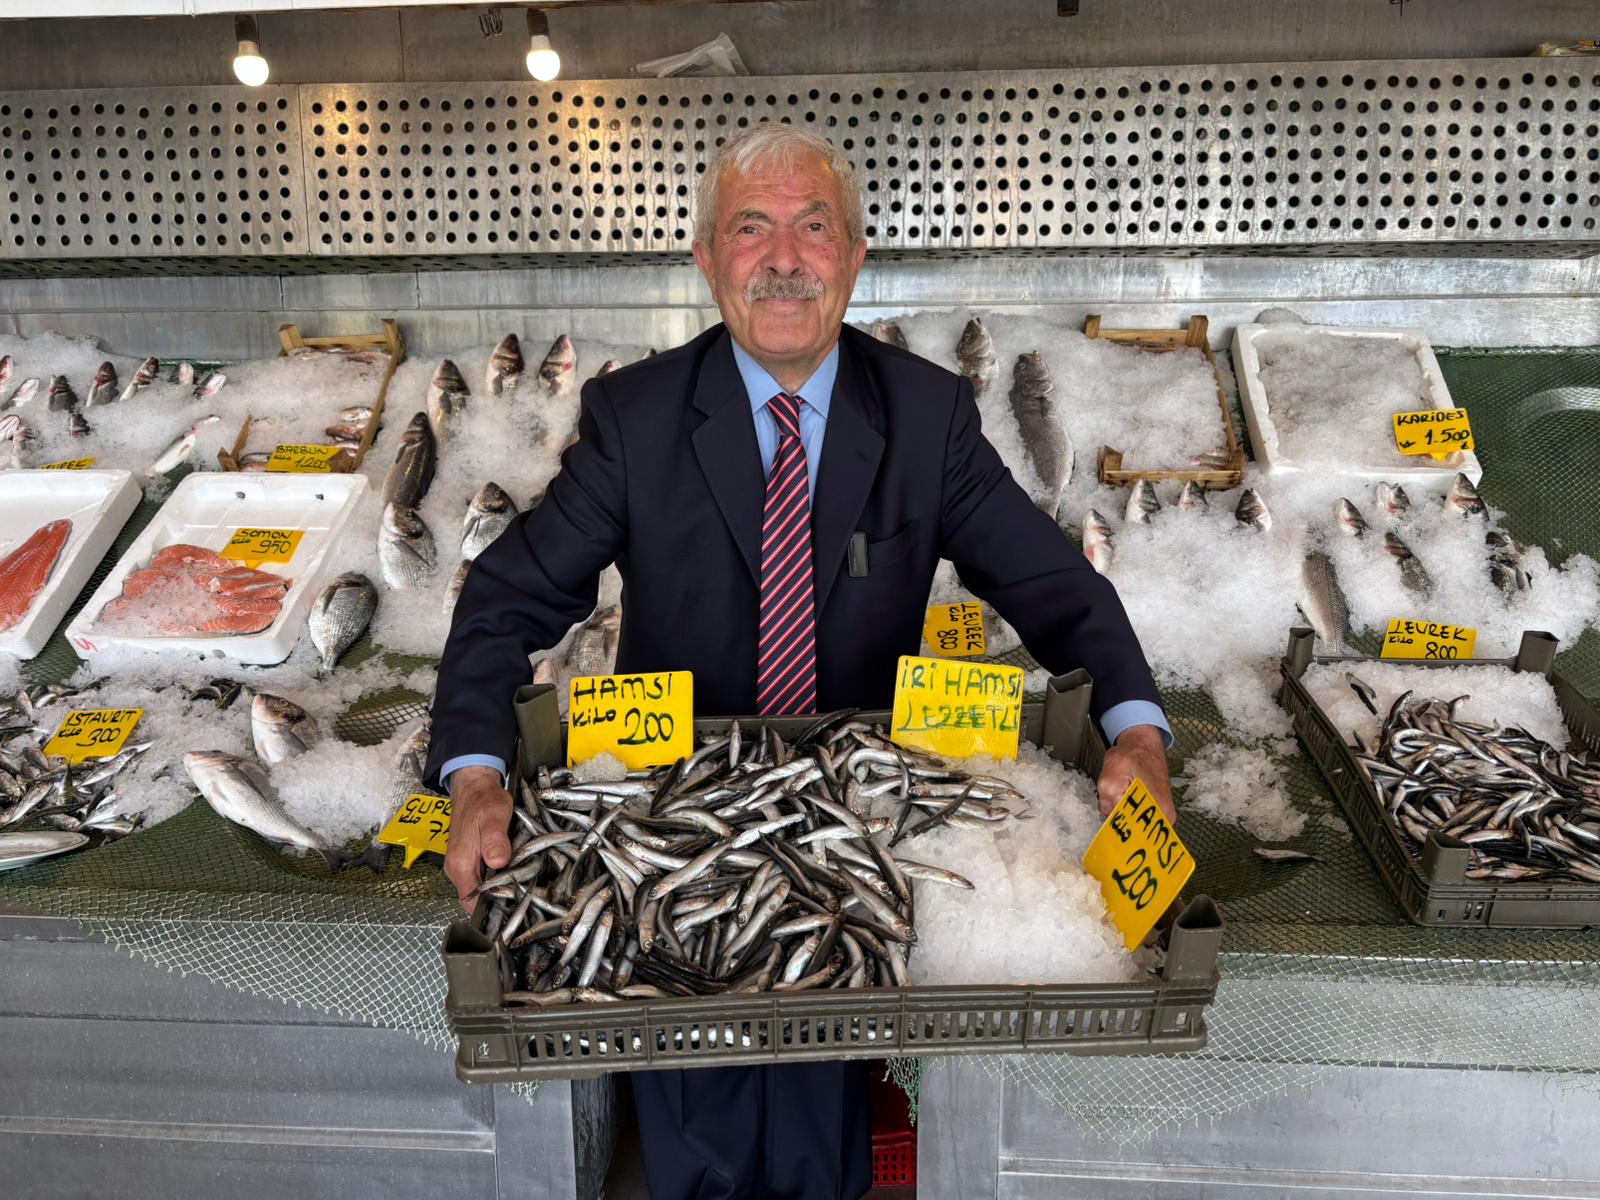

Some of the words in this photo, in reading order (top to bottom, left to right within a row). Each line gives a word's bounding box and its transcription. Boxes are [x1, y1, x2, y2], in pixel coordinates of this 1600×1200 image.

[276, 445, 329, 455] BARBUN
[237, 528, 293, 539] SOMON
[252, 540, 291, 554] 950
[937, 629, 958, 650] 800
[1425, 641, 1457, 660] 800
[573, 673, 672, 705] HAMSI
[617, 707, 674, 745] 200
[76, 728, 121, 746] 300
[1123, 786, 1185, 875] HAMSI
[1111, 848, 1158, 911] 200
